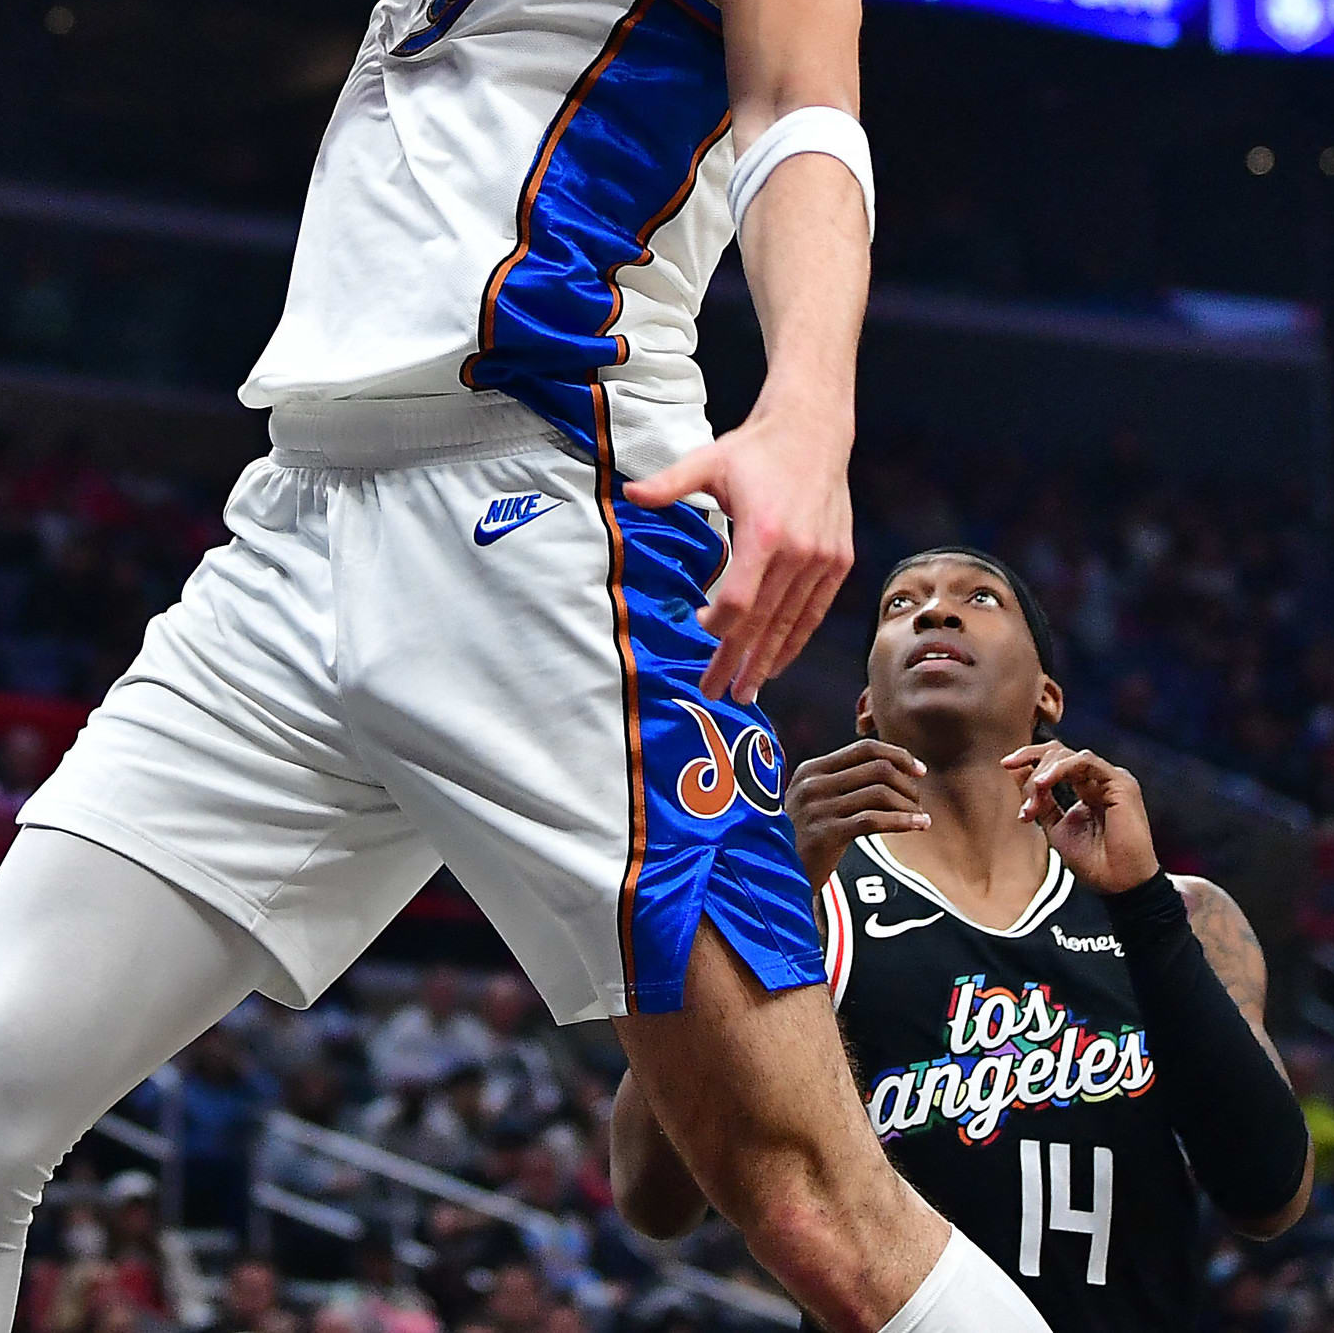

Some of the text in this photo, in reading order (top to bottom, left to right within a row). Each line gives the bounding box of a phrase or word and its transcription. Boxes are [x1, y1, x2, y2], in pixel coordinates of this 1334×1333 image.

[483, 492, 543, 525] NIKE
[855, 875, 888, 904] 6
[1049, 924, 1126, 958] honey
[947, 981, 1067, 1055] los
[867, 1026, 1155, 1141] angeles
[1018, 1139, 1114, 1286] 14
